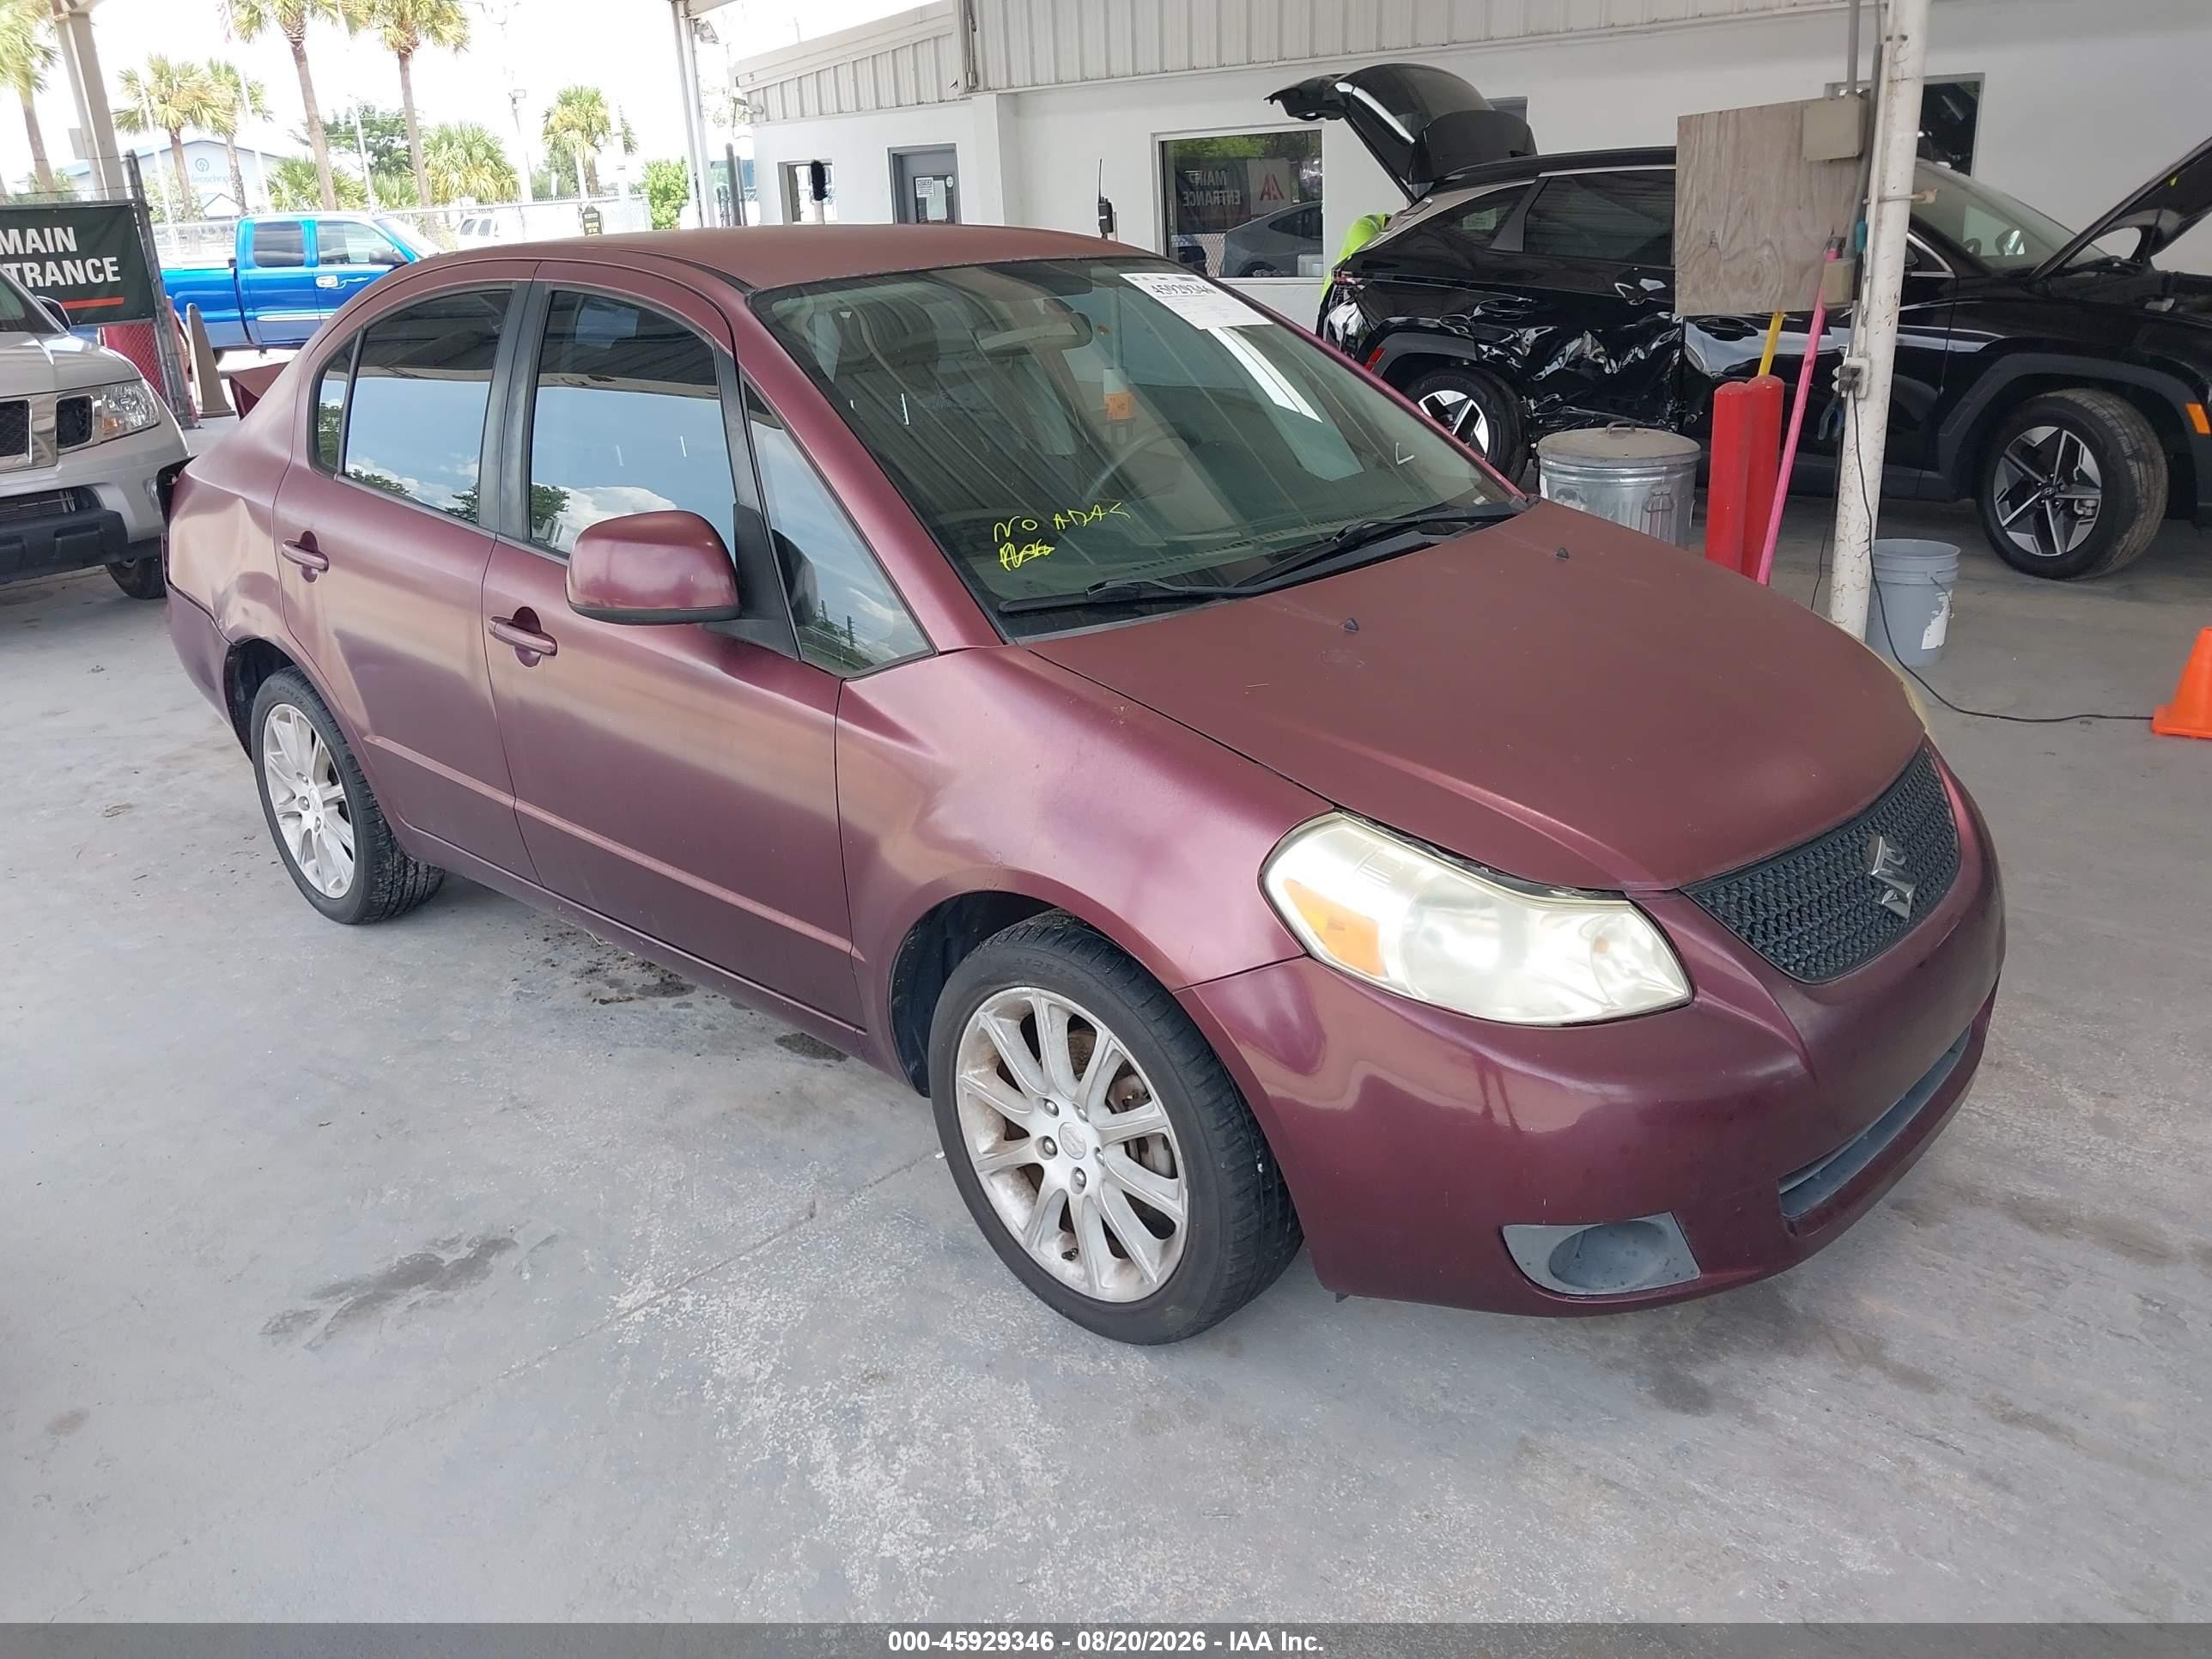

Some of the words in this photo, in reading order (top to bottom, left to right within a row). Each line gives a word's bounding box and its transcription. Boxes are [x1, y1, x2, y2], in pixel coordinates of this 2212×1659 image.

[0, 227, 77, 255] MAIN
[5, 257, 121, 288] TRANCE
[994, 515, 1038, 543] NO
